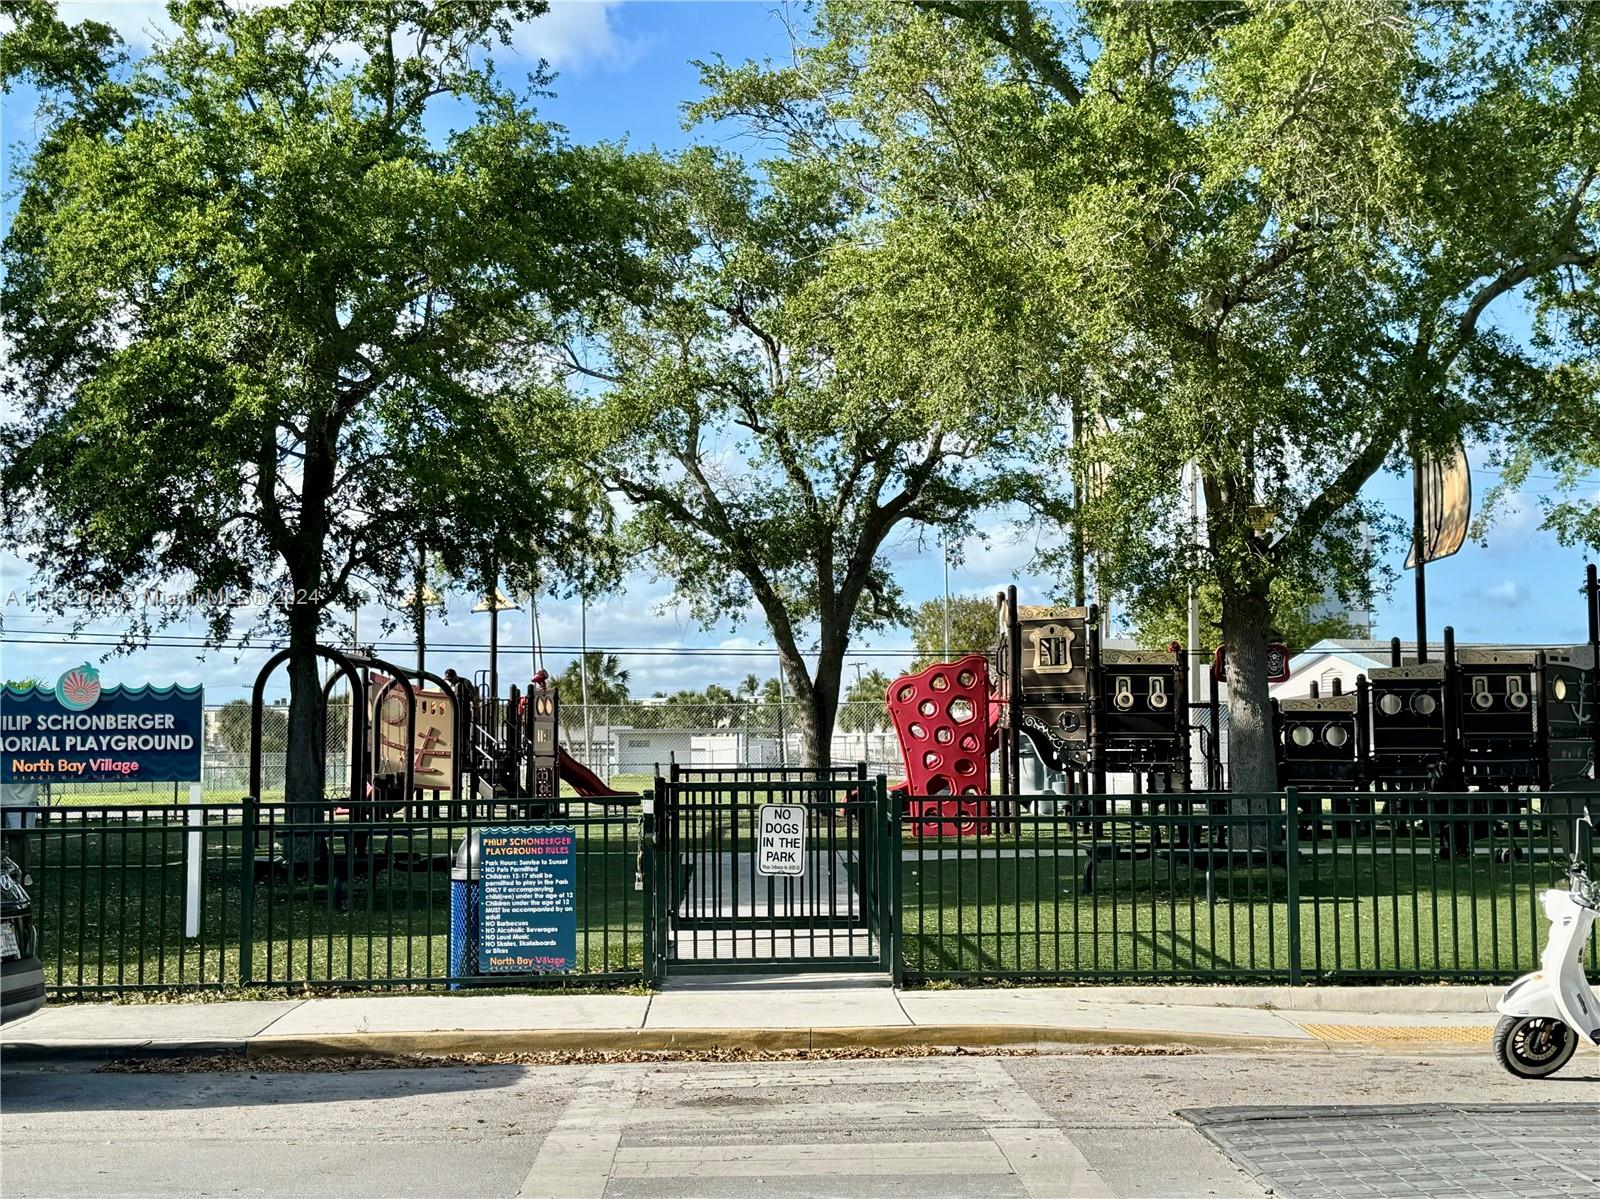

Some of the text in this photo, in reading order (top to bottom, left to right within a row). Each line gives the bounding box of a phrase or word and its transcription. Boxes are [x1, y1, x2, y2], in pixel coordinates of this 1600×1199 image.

[0, 714, 175, 731] ILIP SCHONBERGER
[66, 735, 194, 752] PLAYGROUND
[12, 758, 139, 775] North Bay Village
[774, 809, 791, 820] NO
[766, 823, 798, 834] DOGS
[510, 837, 572, 846] SCHONBERGER
[762, 837, 800, 848] IN THE
[486, 847, 544, 855] PLAYGROUND
[766, 852, 796, 862] PARK
[490, 956, 565, 967] North Bay Village
